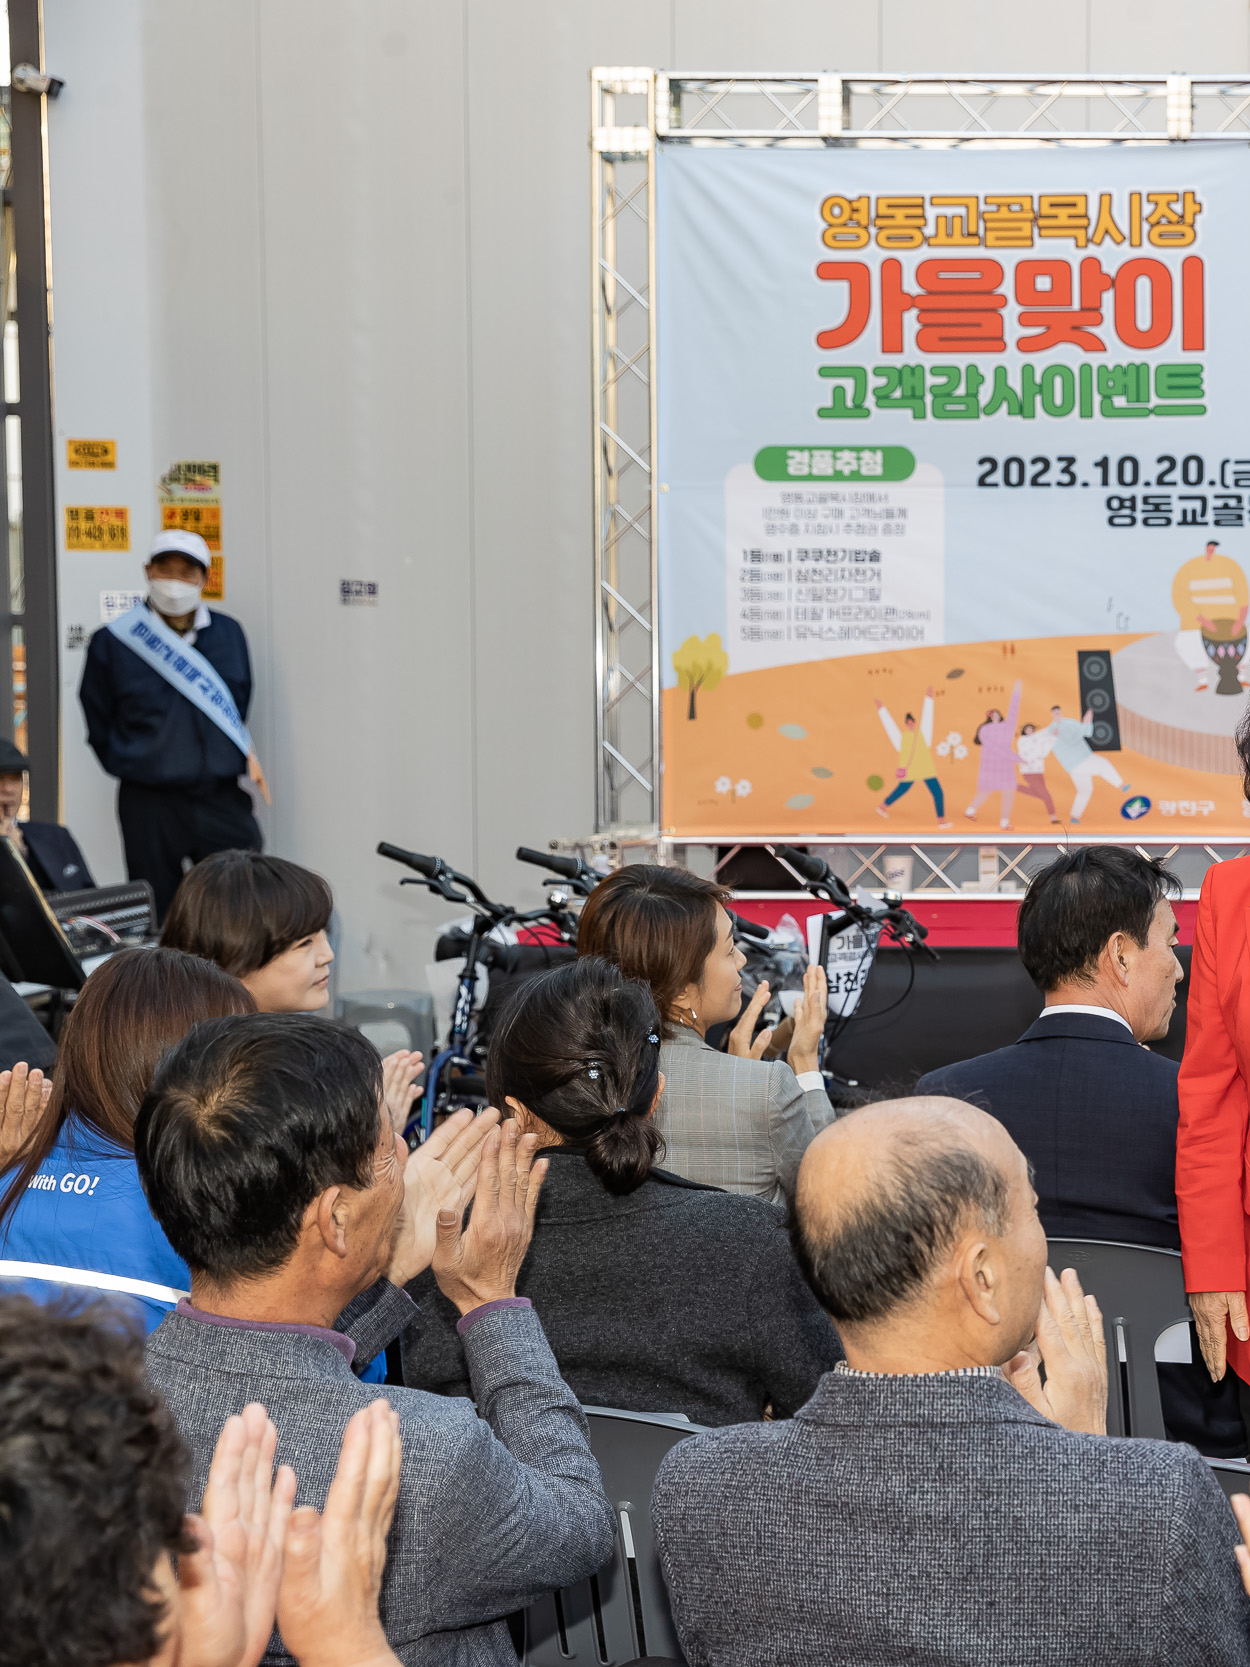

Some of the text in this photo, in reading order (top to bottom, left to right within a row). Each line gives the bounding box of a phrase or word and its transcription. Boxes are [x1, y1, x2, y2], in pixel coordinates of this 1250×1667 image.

[819, 191, 1202, 249] 영동교골목시장
[816, 255, 1205, 353] 가을맞이
[817, 363, 1207, 419] 고객감사이벤트
[786, 450, 884, 476] 경품추첨
[28, 1172, 100, 1196] With GO!
